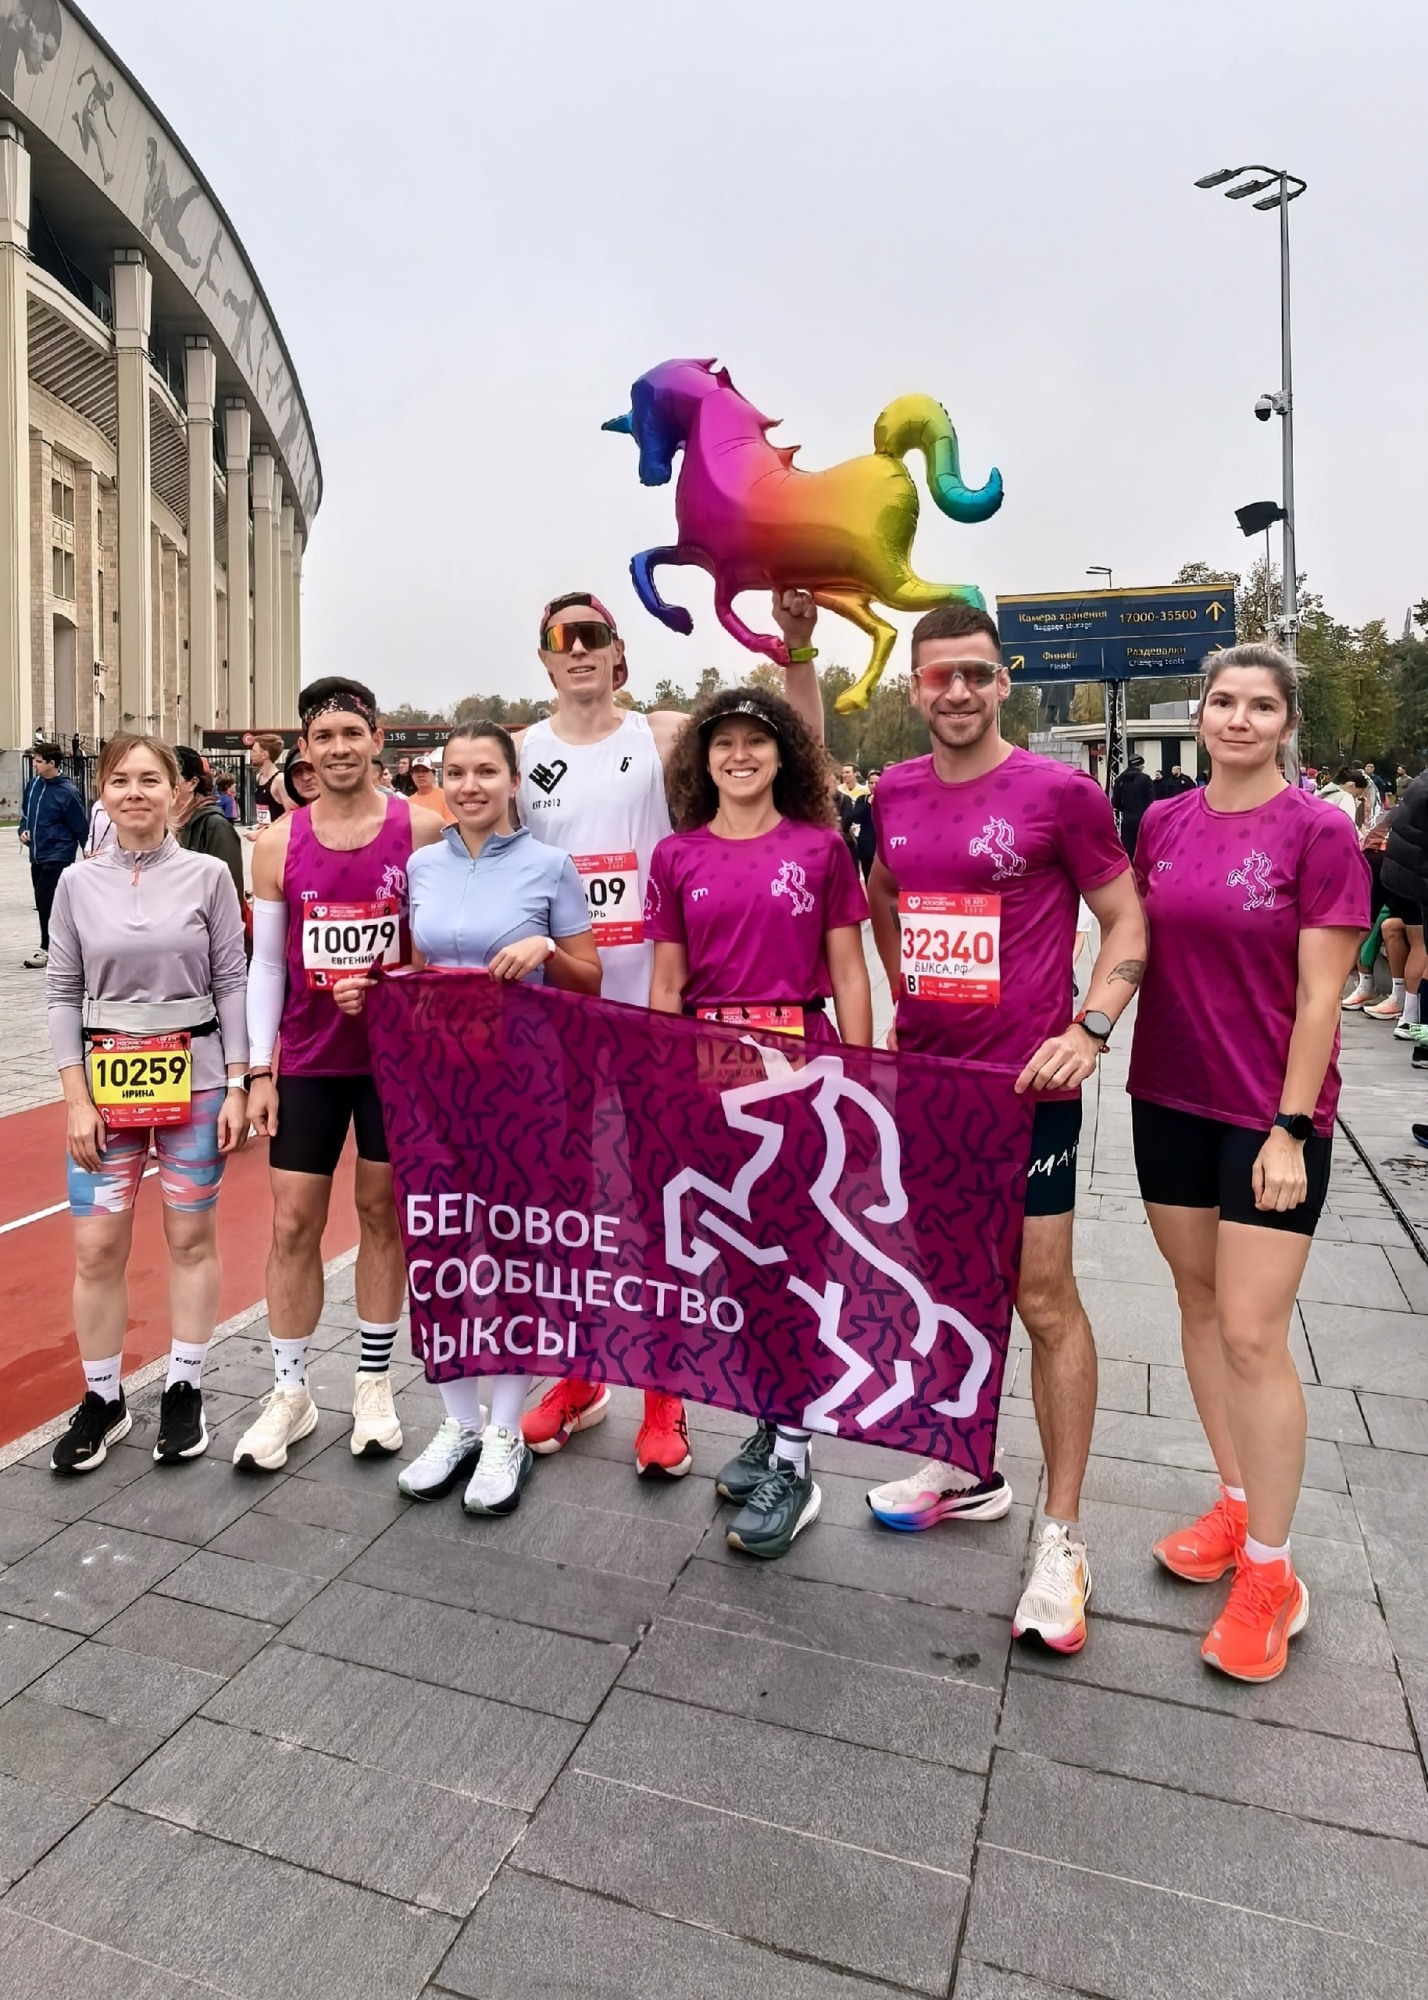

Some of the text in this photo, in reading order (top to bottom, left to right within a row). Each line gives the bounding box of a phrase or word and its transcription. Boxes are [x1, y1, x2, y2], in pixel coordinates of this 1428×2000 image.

[1018, 610, 1108, 623] Камера хранения
[1119, 609, 1197, 623] 17000-35500
[1042, 650, 1078, 661] Финиш
[1126, 646, 1187, 657] Раздевалки
[1049, 662, 1072, 670] Finish
[585, 877, 626, 906] 09
[308, 921, 396, 954] 10079
[902, 927, 994, 965] 32340
[331, 953, 375, 965] ЕВГЕНИЙ
[97, 1056, 187, 1087] 10259
[122, 1089, 155, 1099] ИРИНА
[407, 1193, 621, 1254] БЕГОВОЕ
[408, 1254, 744, 1333] СООБЩЕСТВО
